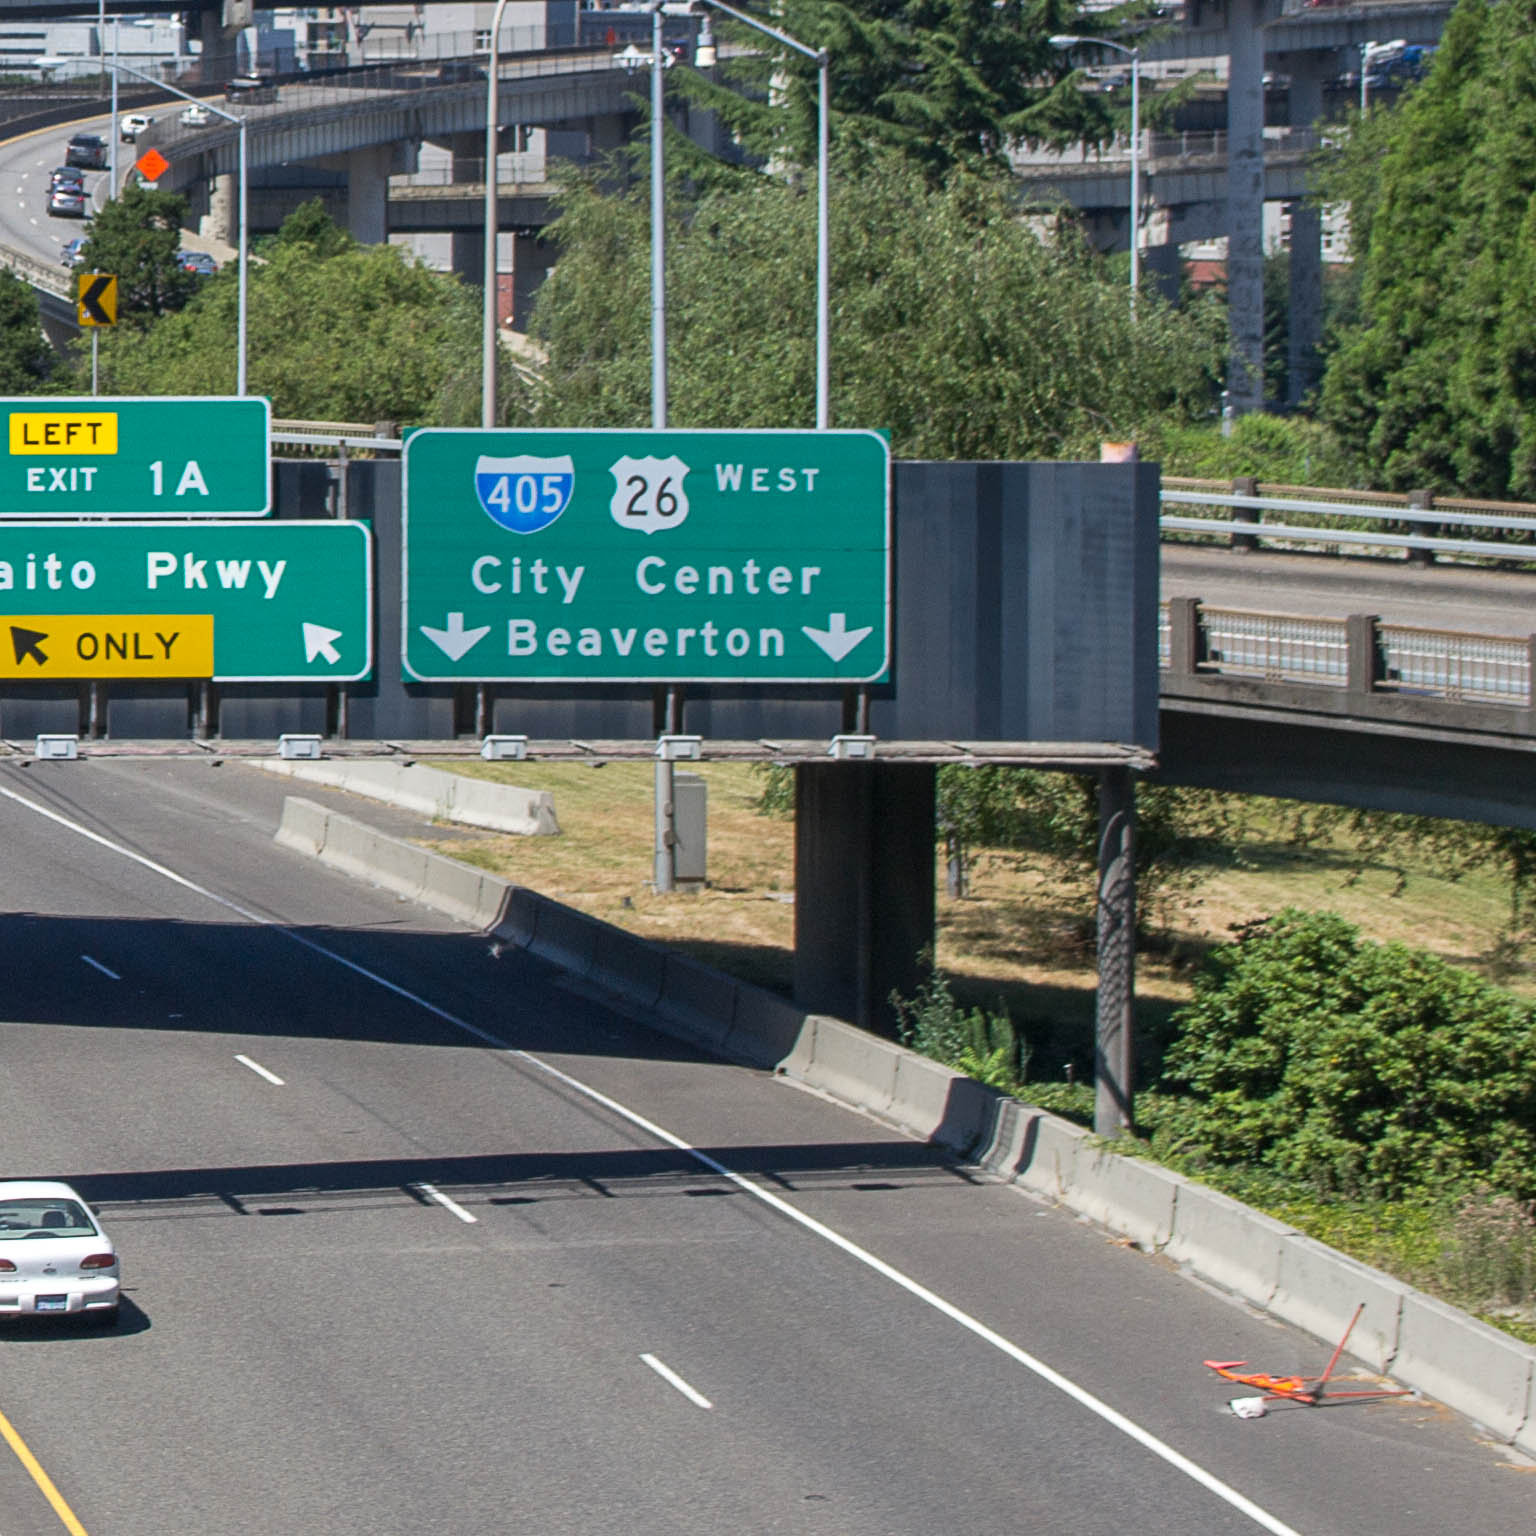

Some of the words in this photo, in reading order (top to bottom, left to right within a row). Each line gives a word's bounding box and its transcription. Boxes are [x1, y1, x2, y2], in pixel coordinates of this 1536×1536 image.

[22, 422, 103, 446] LEFT
[26, 466, 99, 492] EXIT
[149, 460, 210, 497] 1A
[486, 474, 564, 514] 405
[625, 474, 678, 517] 26
[715, 463, 821, 492] WEST
[146, 551, 288, 599] Pkwy
[470, 555, 585, 604] City
[636, 555, 822, 595] Center
[76, 632, 180, 661] ONLY
[507, 618, 785, 657] Beaverton
